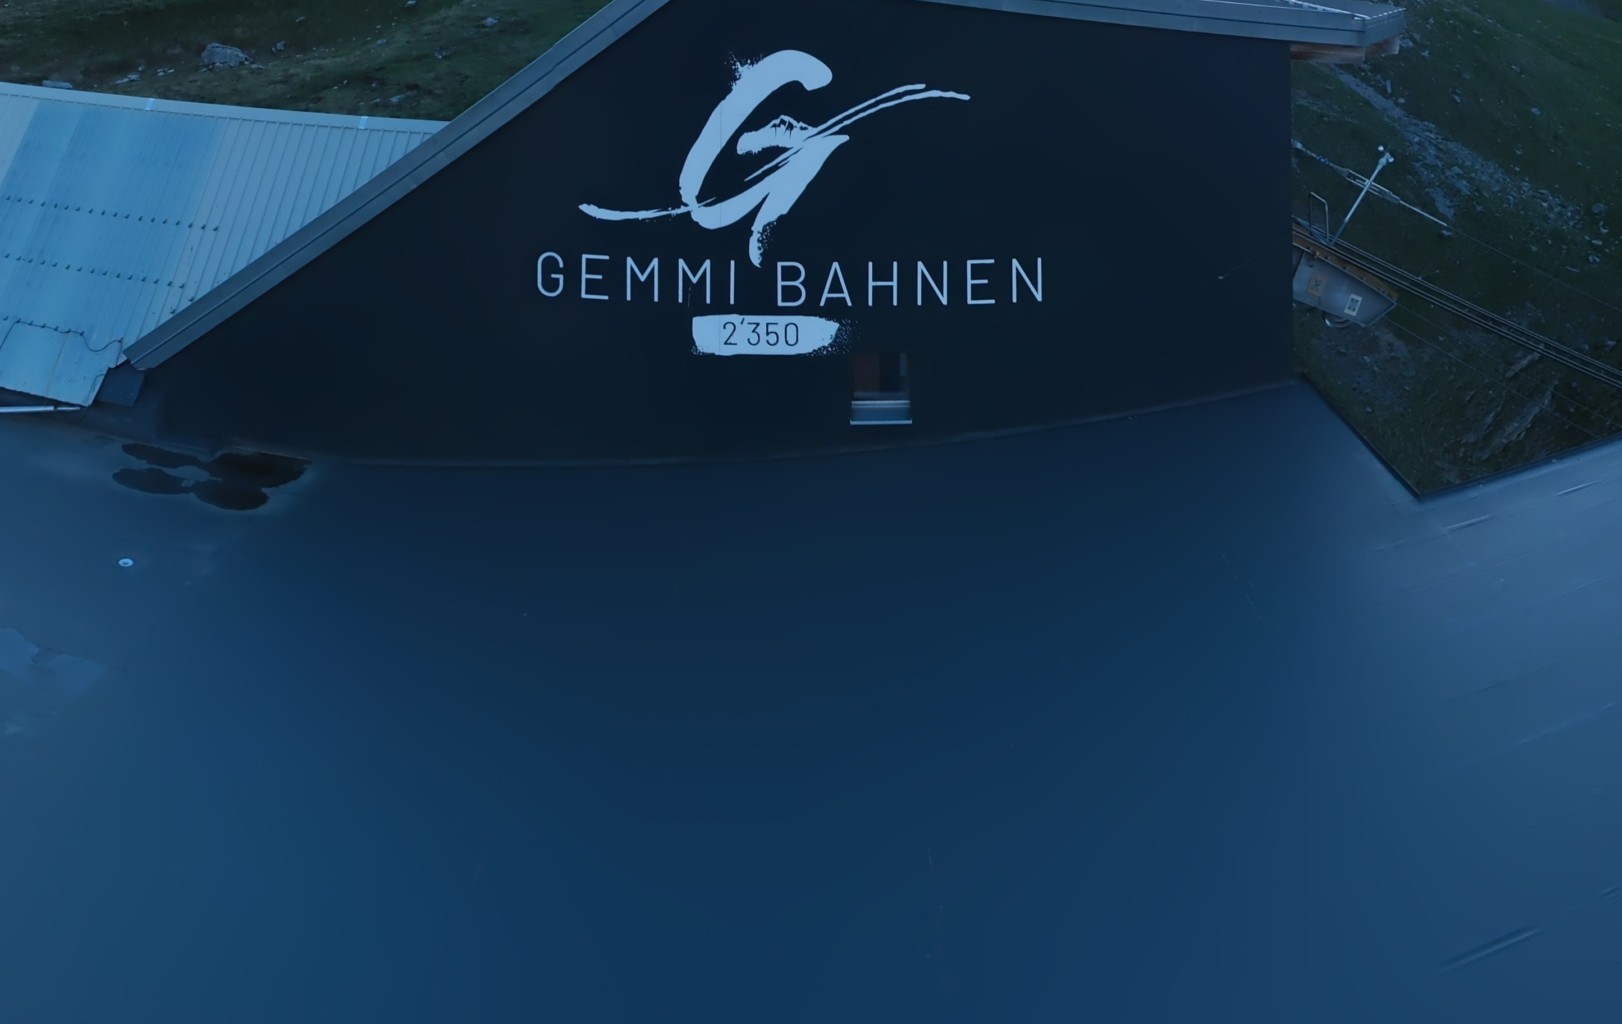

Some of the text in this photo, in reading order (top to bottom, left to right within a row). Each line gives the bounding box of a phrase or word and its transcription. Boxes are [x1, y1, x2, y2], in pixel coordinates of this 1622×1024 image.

[537, 251, 1043, 307] GEMMI BAHNEN
[722, 317, 799, 347] 2'350
